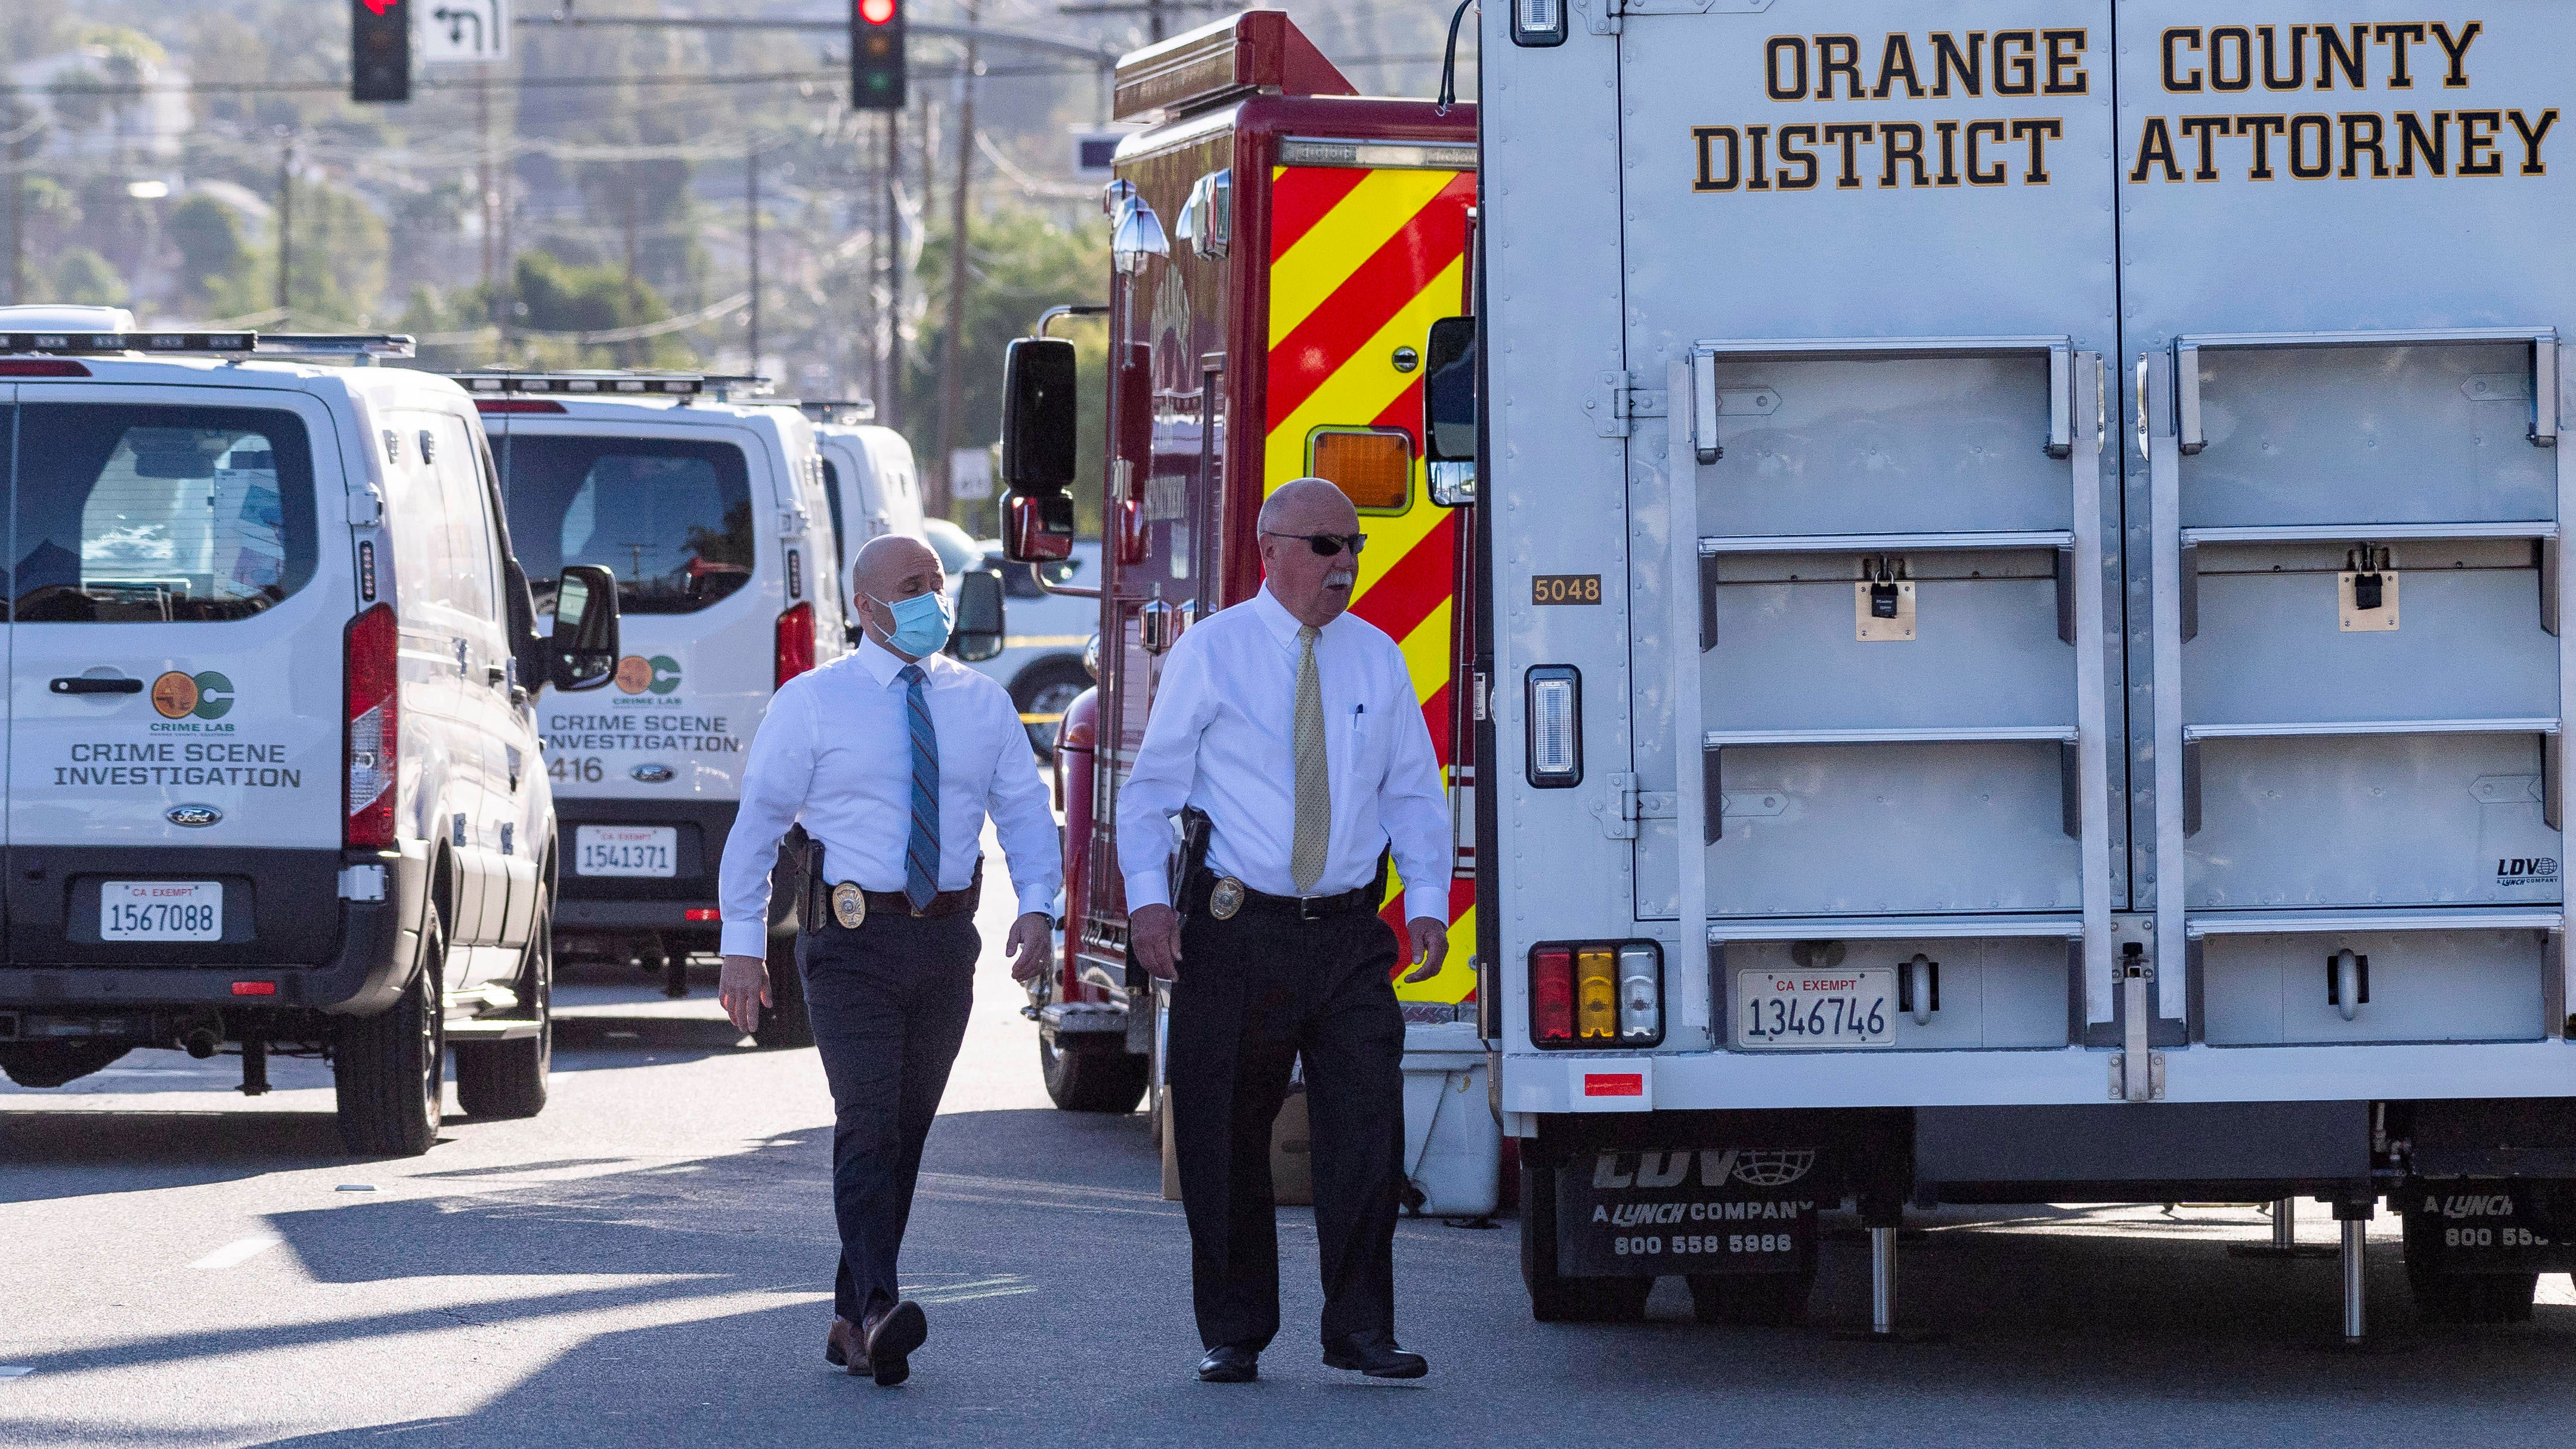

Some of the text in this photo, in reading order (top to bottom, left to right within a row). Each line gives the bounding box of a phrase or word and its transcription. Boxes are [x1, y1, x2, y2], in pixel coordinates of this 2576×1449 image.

[1763, 20, 2483, 103] ORANGE COUNTY
[1690, 108, 2560, 193] DISTRICT ATTORNEY
[1534, 578, 1599, 601] 5048
[150, 723, 235, 732] CRIME LAB
[551, 715, 727, 733] CRIME SCENE
[71, 744, 286, 763] CRIME SCENE
[54, 767, 301, 788] INVESTIGATION
[547, 757, 603, 783] 416
[585, 845, 668, 868] 1541371
[2497, 858, 2540, 875] LDV
[131, 888, 193, 897] CA EXEMPT
[111, 904, 213, 931] 1567088
[1776, 980, 1857, 991] CA EXEMPT
[1748, 998, 1884, 1035] 1346746
[1592, 1205, 1609, 1222] A
[1611, 1203, 1687, 1227] LYNCH
[2423, 1196, 2439, 1213] A
[1615, 1234, 1791, 1255] 800 558 5986
[2445, 1228, 2492, 1246] 800
